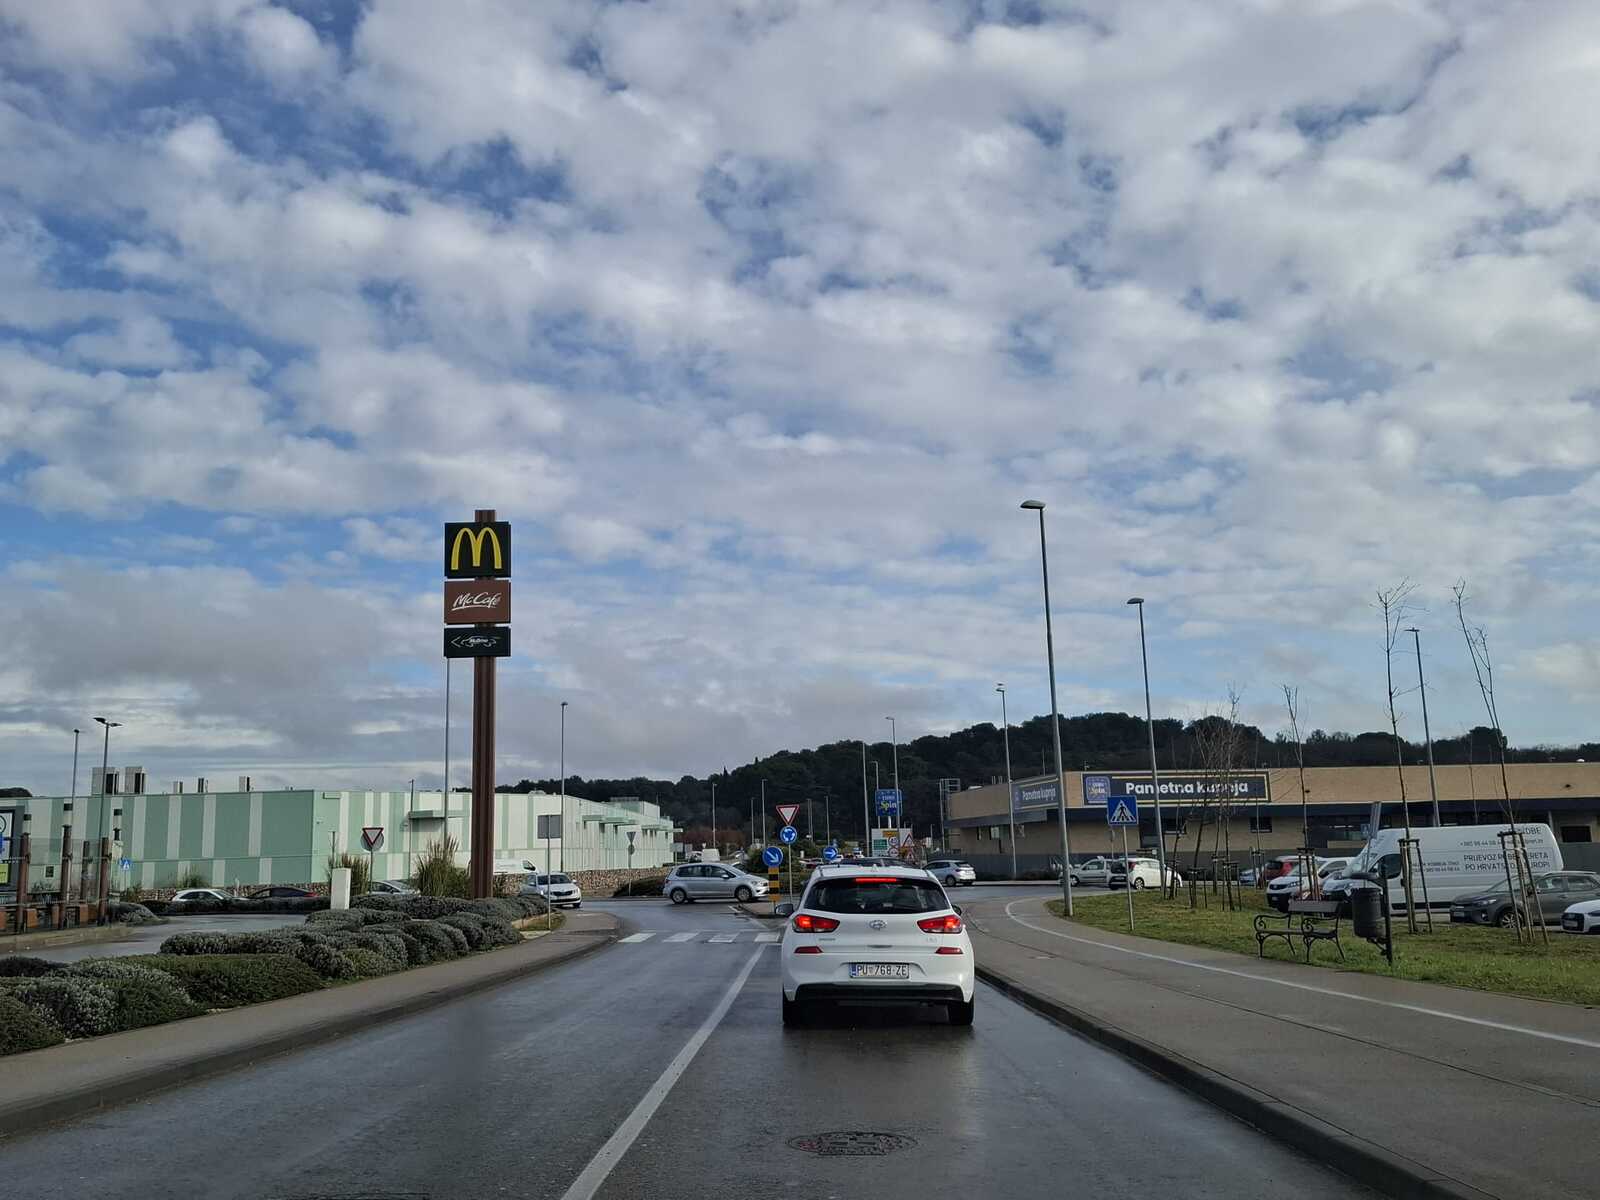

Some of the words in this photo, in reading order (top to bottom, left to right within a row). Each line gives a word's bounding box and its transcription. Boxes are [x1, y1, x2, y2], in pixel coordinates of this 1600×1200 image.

[1125, 782, 1194, 795] Pametna
[1196, 780, 1249, 797] kupnja
[1463, 853, 1497, 862] PRIJEVOZ
[856, 964, 869, 976] PU
